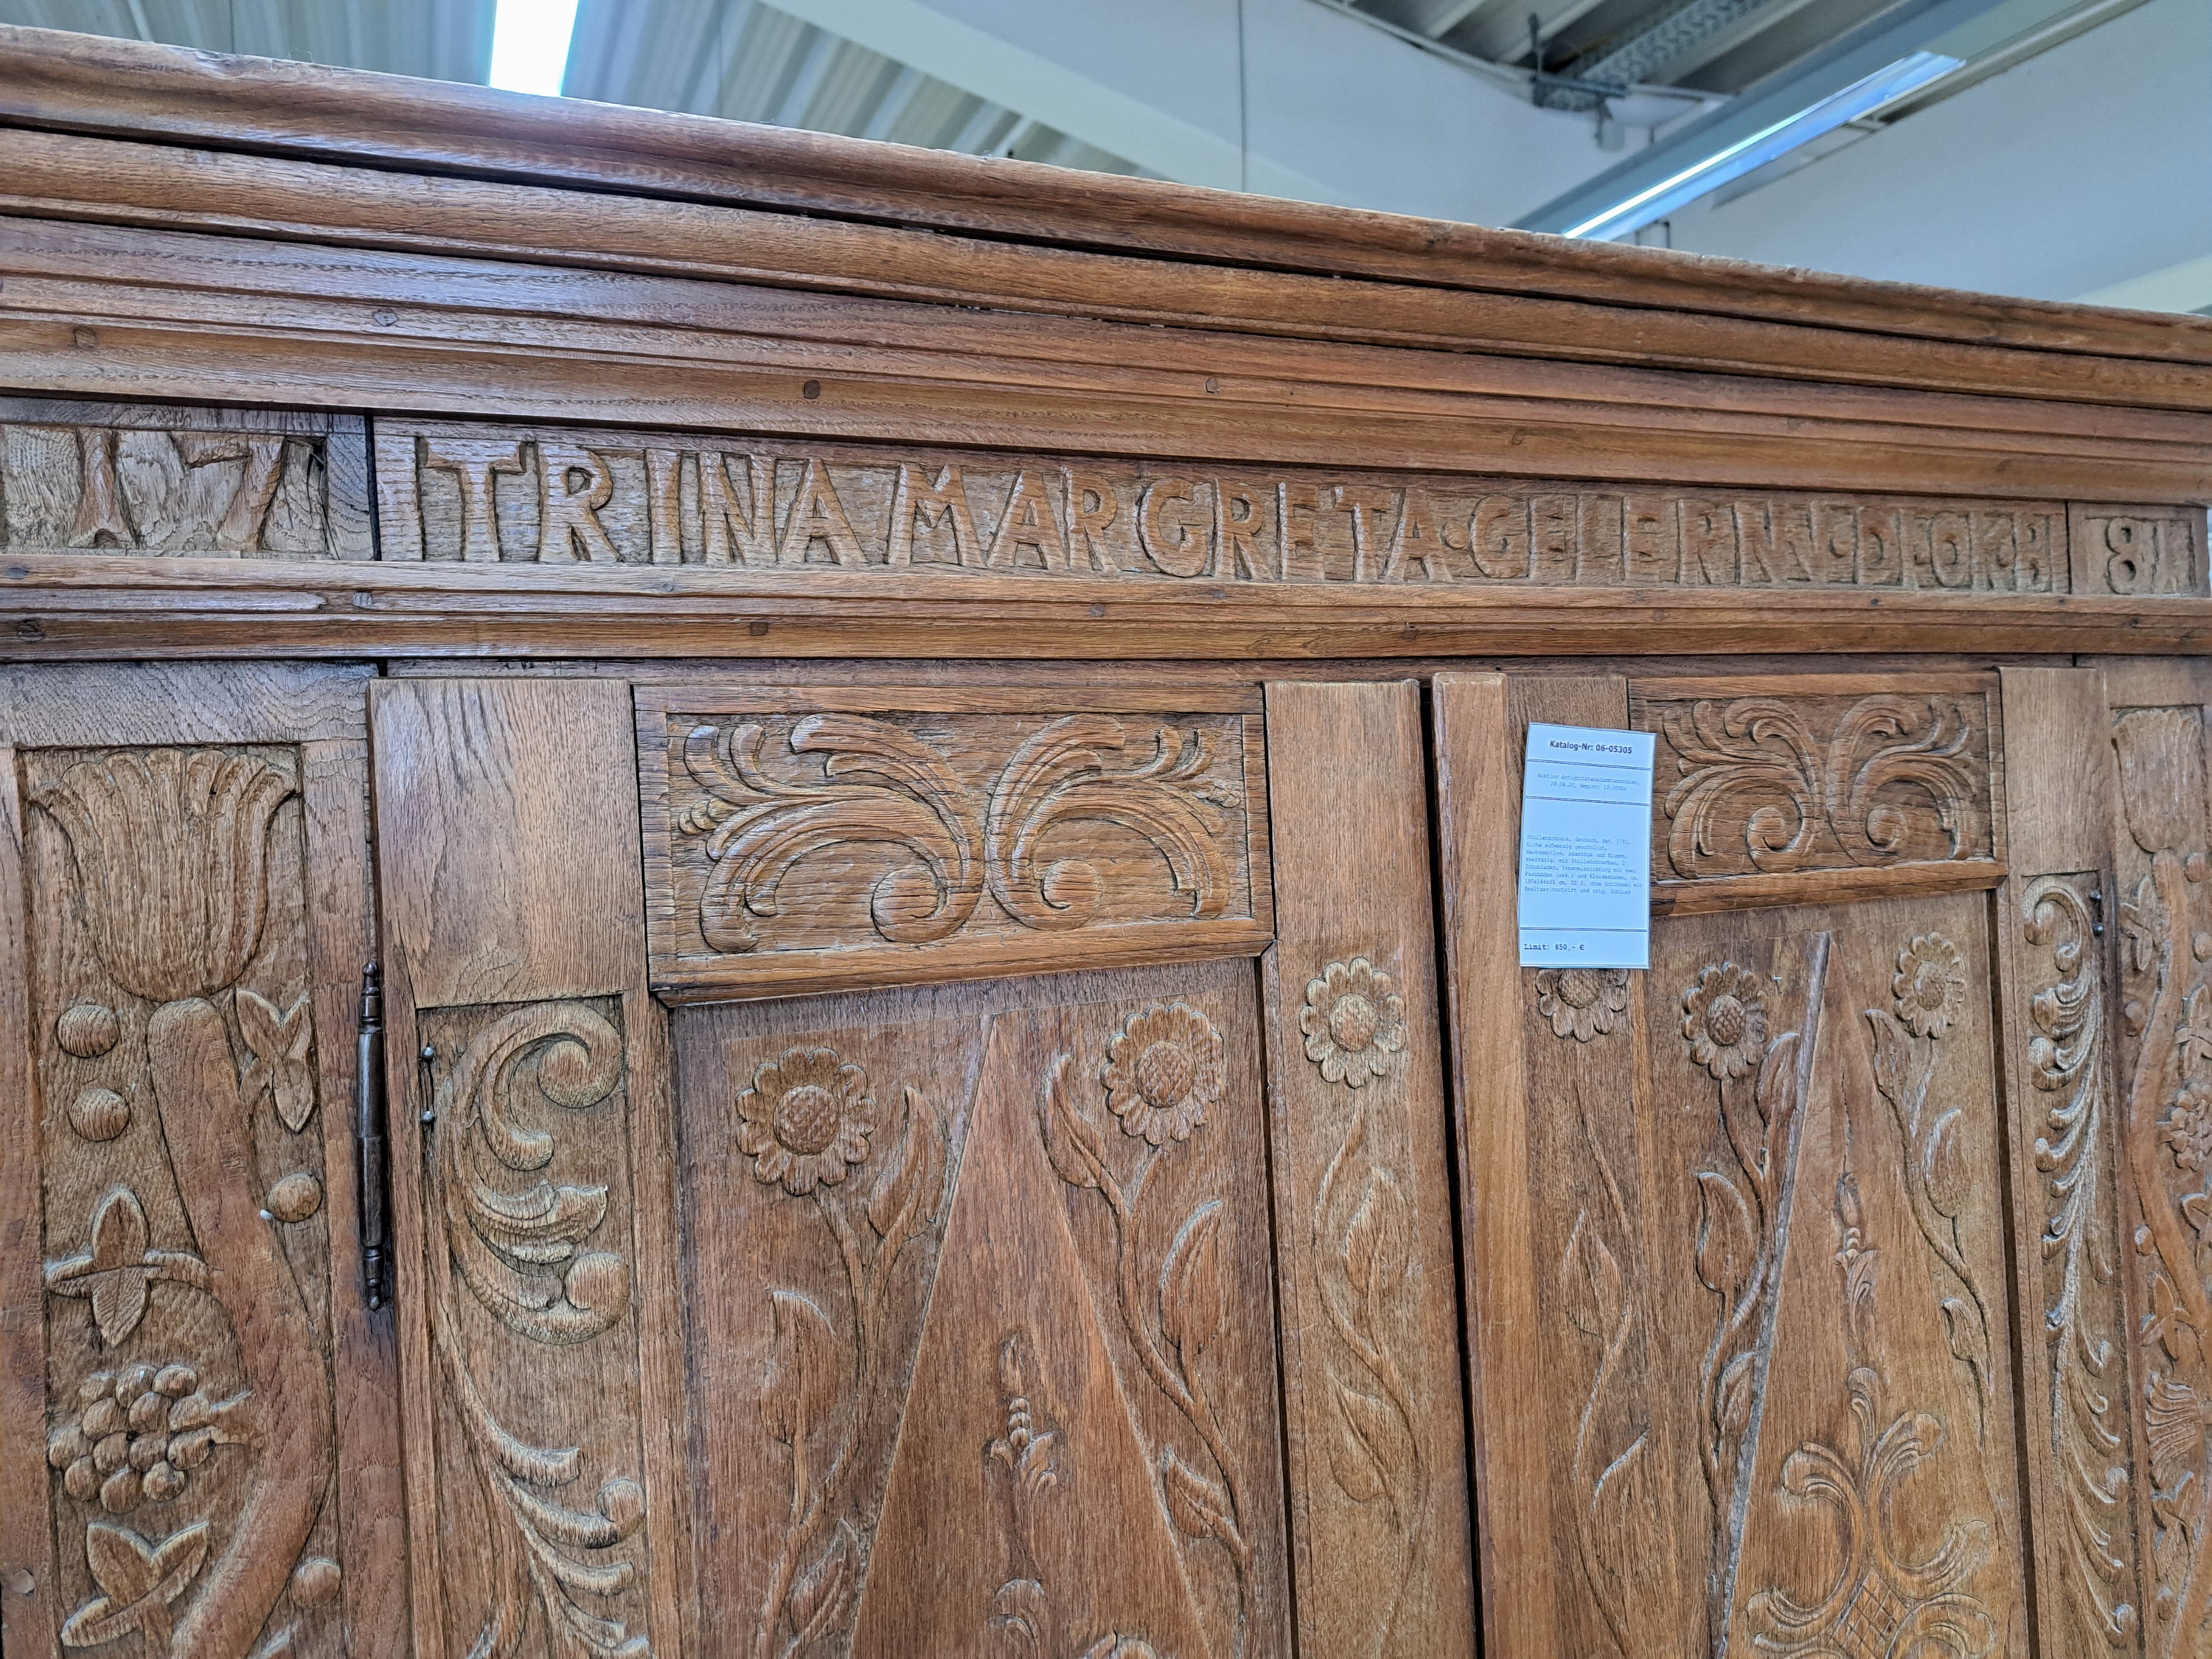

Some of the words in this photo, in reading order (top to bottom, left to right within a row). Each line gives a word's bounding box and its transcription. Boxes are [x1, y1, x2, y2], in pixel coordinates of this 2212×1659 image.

[422, 435, 872, 566] TRINA
[885, 459, 1454, 583] MARGRETA
[1550, 740, 1593, 751] Katalog-Nr:
[1596, 745, 1632, 754] 06-05305
